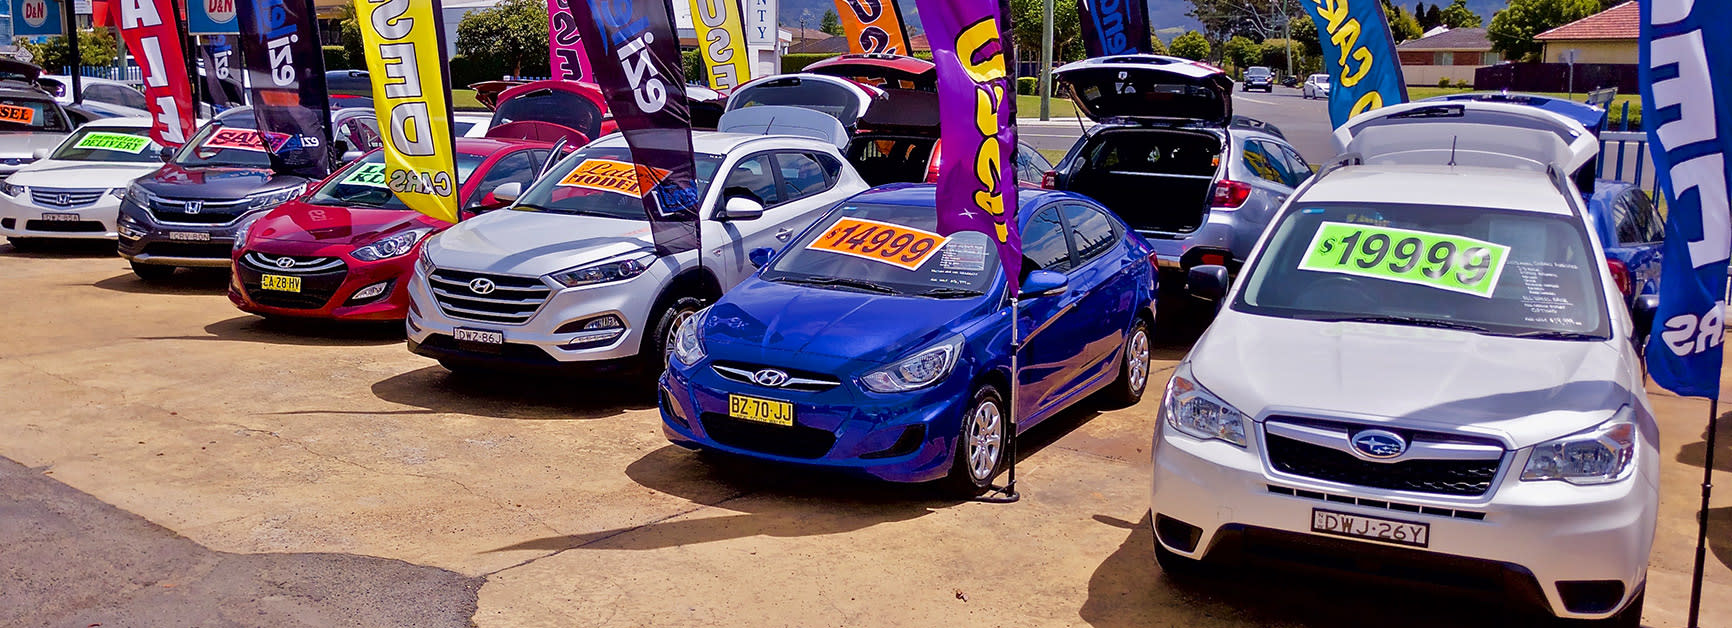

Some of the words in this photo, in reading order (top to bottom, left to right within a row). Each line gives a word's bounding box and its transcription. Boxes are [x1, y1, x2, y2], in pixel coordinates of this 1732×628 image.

[25, 2, 44, 19] D&N
[208, 0, 233, 13] D&N
[79, 139, 139, 151] DELIVERY
[825, 223, 936, 263] $14999
[1319, 230, 1492, 286] $19999
